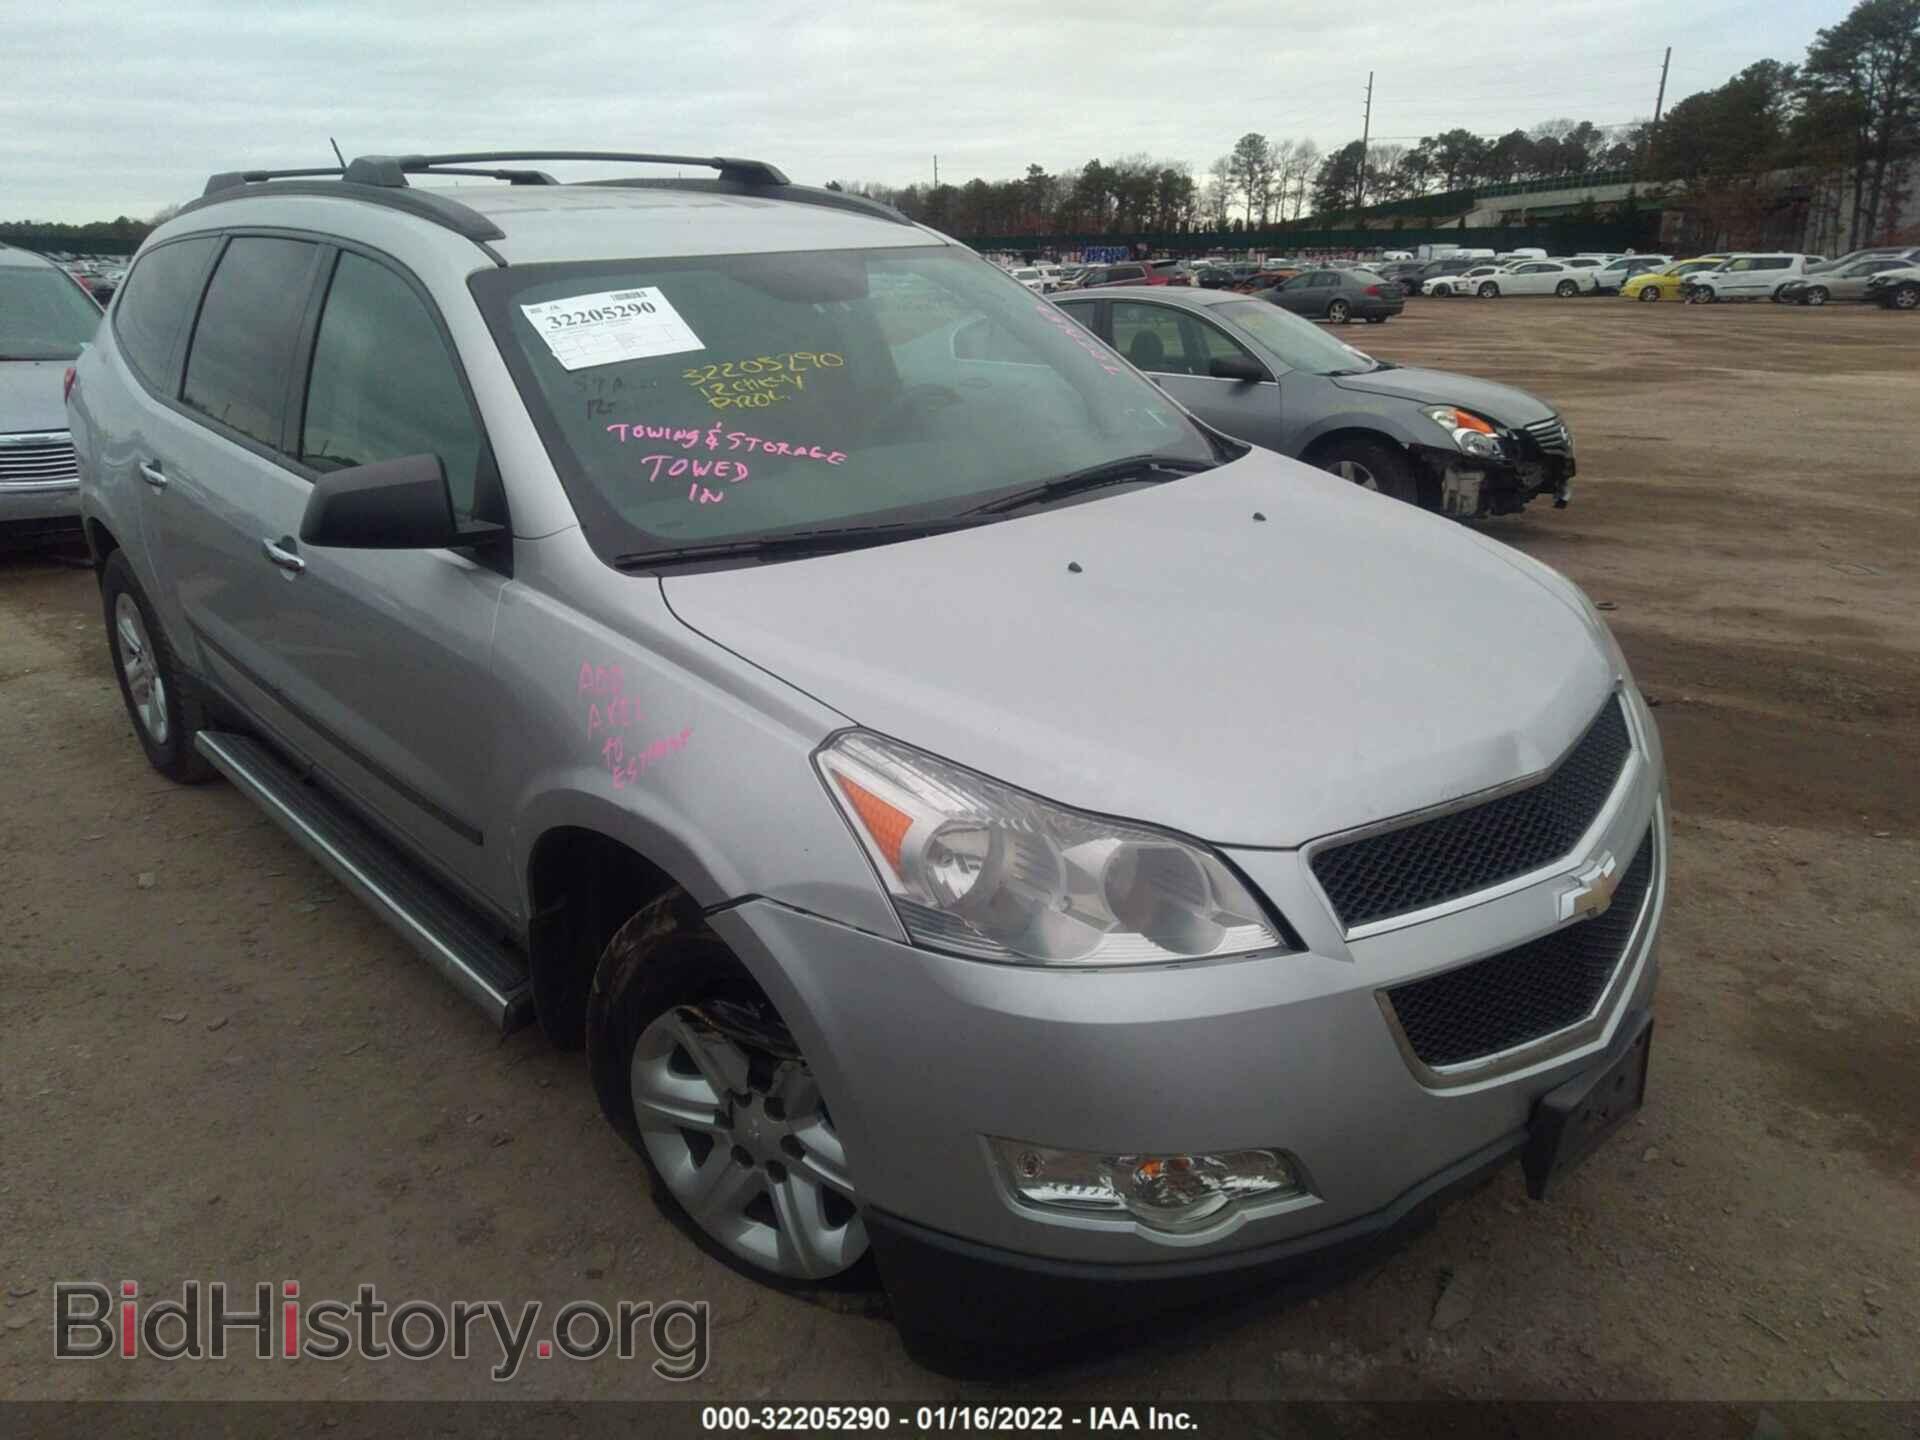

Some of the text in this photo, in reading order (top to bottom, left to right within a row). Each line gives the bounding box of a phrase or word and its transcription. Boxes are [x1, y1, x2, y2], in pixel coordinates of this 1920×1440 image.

[545, 301, 657, 330] 32205290
[682, 352, 844, 386] 32205290
[607, 423, 699, 448] TOWING
[727, 432, 849, 465] STORAGE
[641, 454, 749, 482] TOWED
[688, 483, 724, 503] IN
